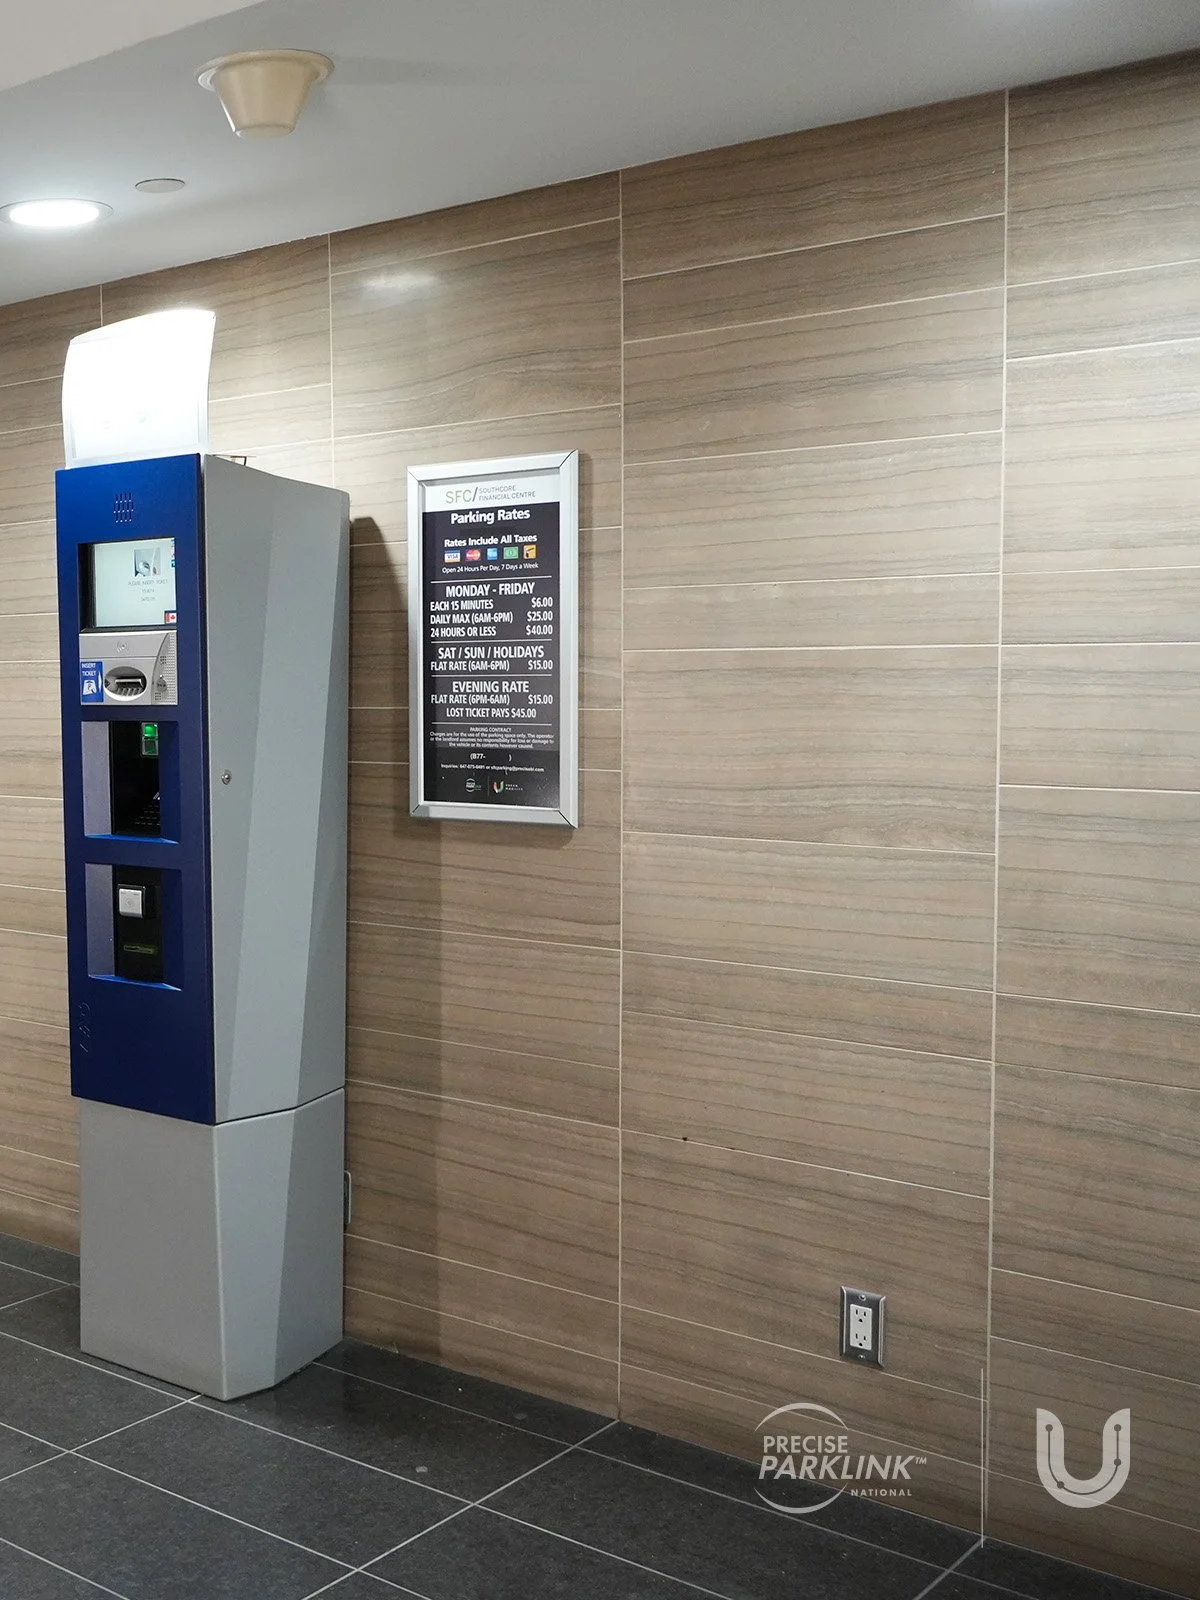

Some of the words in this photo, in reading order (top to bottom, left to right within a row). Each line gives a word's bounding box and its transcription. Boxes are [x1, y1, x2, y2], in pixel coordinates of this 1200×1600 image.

[479, 485, 516, 493] SOUTHCORE
[479, 493, 510, 502] FINANCIAL
[511, 491, 535, 499] CENTRE
[451, 512, 494, 524] Parking
[498, 509, 530, 520] Rates
[444, 538, 467, 548] Rates
[469, 536, 498, 546] Include
[500, 535, 512, 544] All
[514, 534, 538, 543] Taxes
[489, 564, 500, 572] Day,
[506, 563, 518, 571] Days
[446, 584, 491, 597] MONDAY
[499, 582, 535, 595] FRIDAY
[430, 602, 449, 611] EACH
[451, 601, 459, 610] 15
[461, 599, 494, 610] MINUTES
[532, 597, 553, 608] $6.00
[430, 614, 451, 624] DAILY
[452, 614, 470, 623] MAX
[472, 611, 513, 624] (6AM-6PM)
[527, 611, 553, 622] $25.00
[431, 628, 439, 638] 24
[440, 627, 466, 637] HOURS
[467, 627, 478, 636] OR
[479, 626, 496, 636] LESS
[526, 625, 553, 636] $40.00
[438, 648, 457, 659] SAT
[464, 647, 486, 659] SUN
[493, 646, 544, 659] HOLIDAYS
[431, 661, 448, 671] FLAT
[449, 661, 467, 671] RATE
[468, 660, 510, 672] (6AM-6PM)
[528, 660, 553, 670] $15.00
[452, 681, 499, 693] EVENING
[502, 681, 529, 693] RATE
[431, 695, 448, 704] FLAT
[449, 694, 467, 704] RATE
[468, 694, 510, 706] (6PM-6AM)
[528, 694, 553, 705] $15.00
[446, 708, 464, 717] LOST
[465, 708, 490, 718] TICKET
[491, 708, 510, 718] PAYS
[511, 708, 536, 718] $45.00
